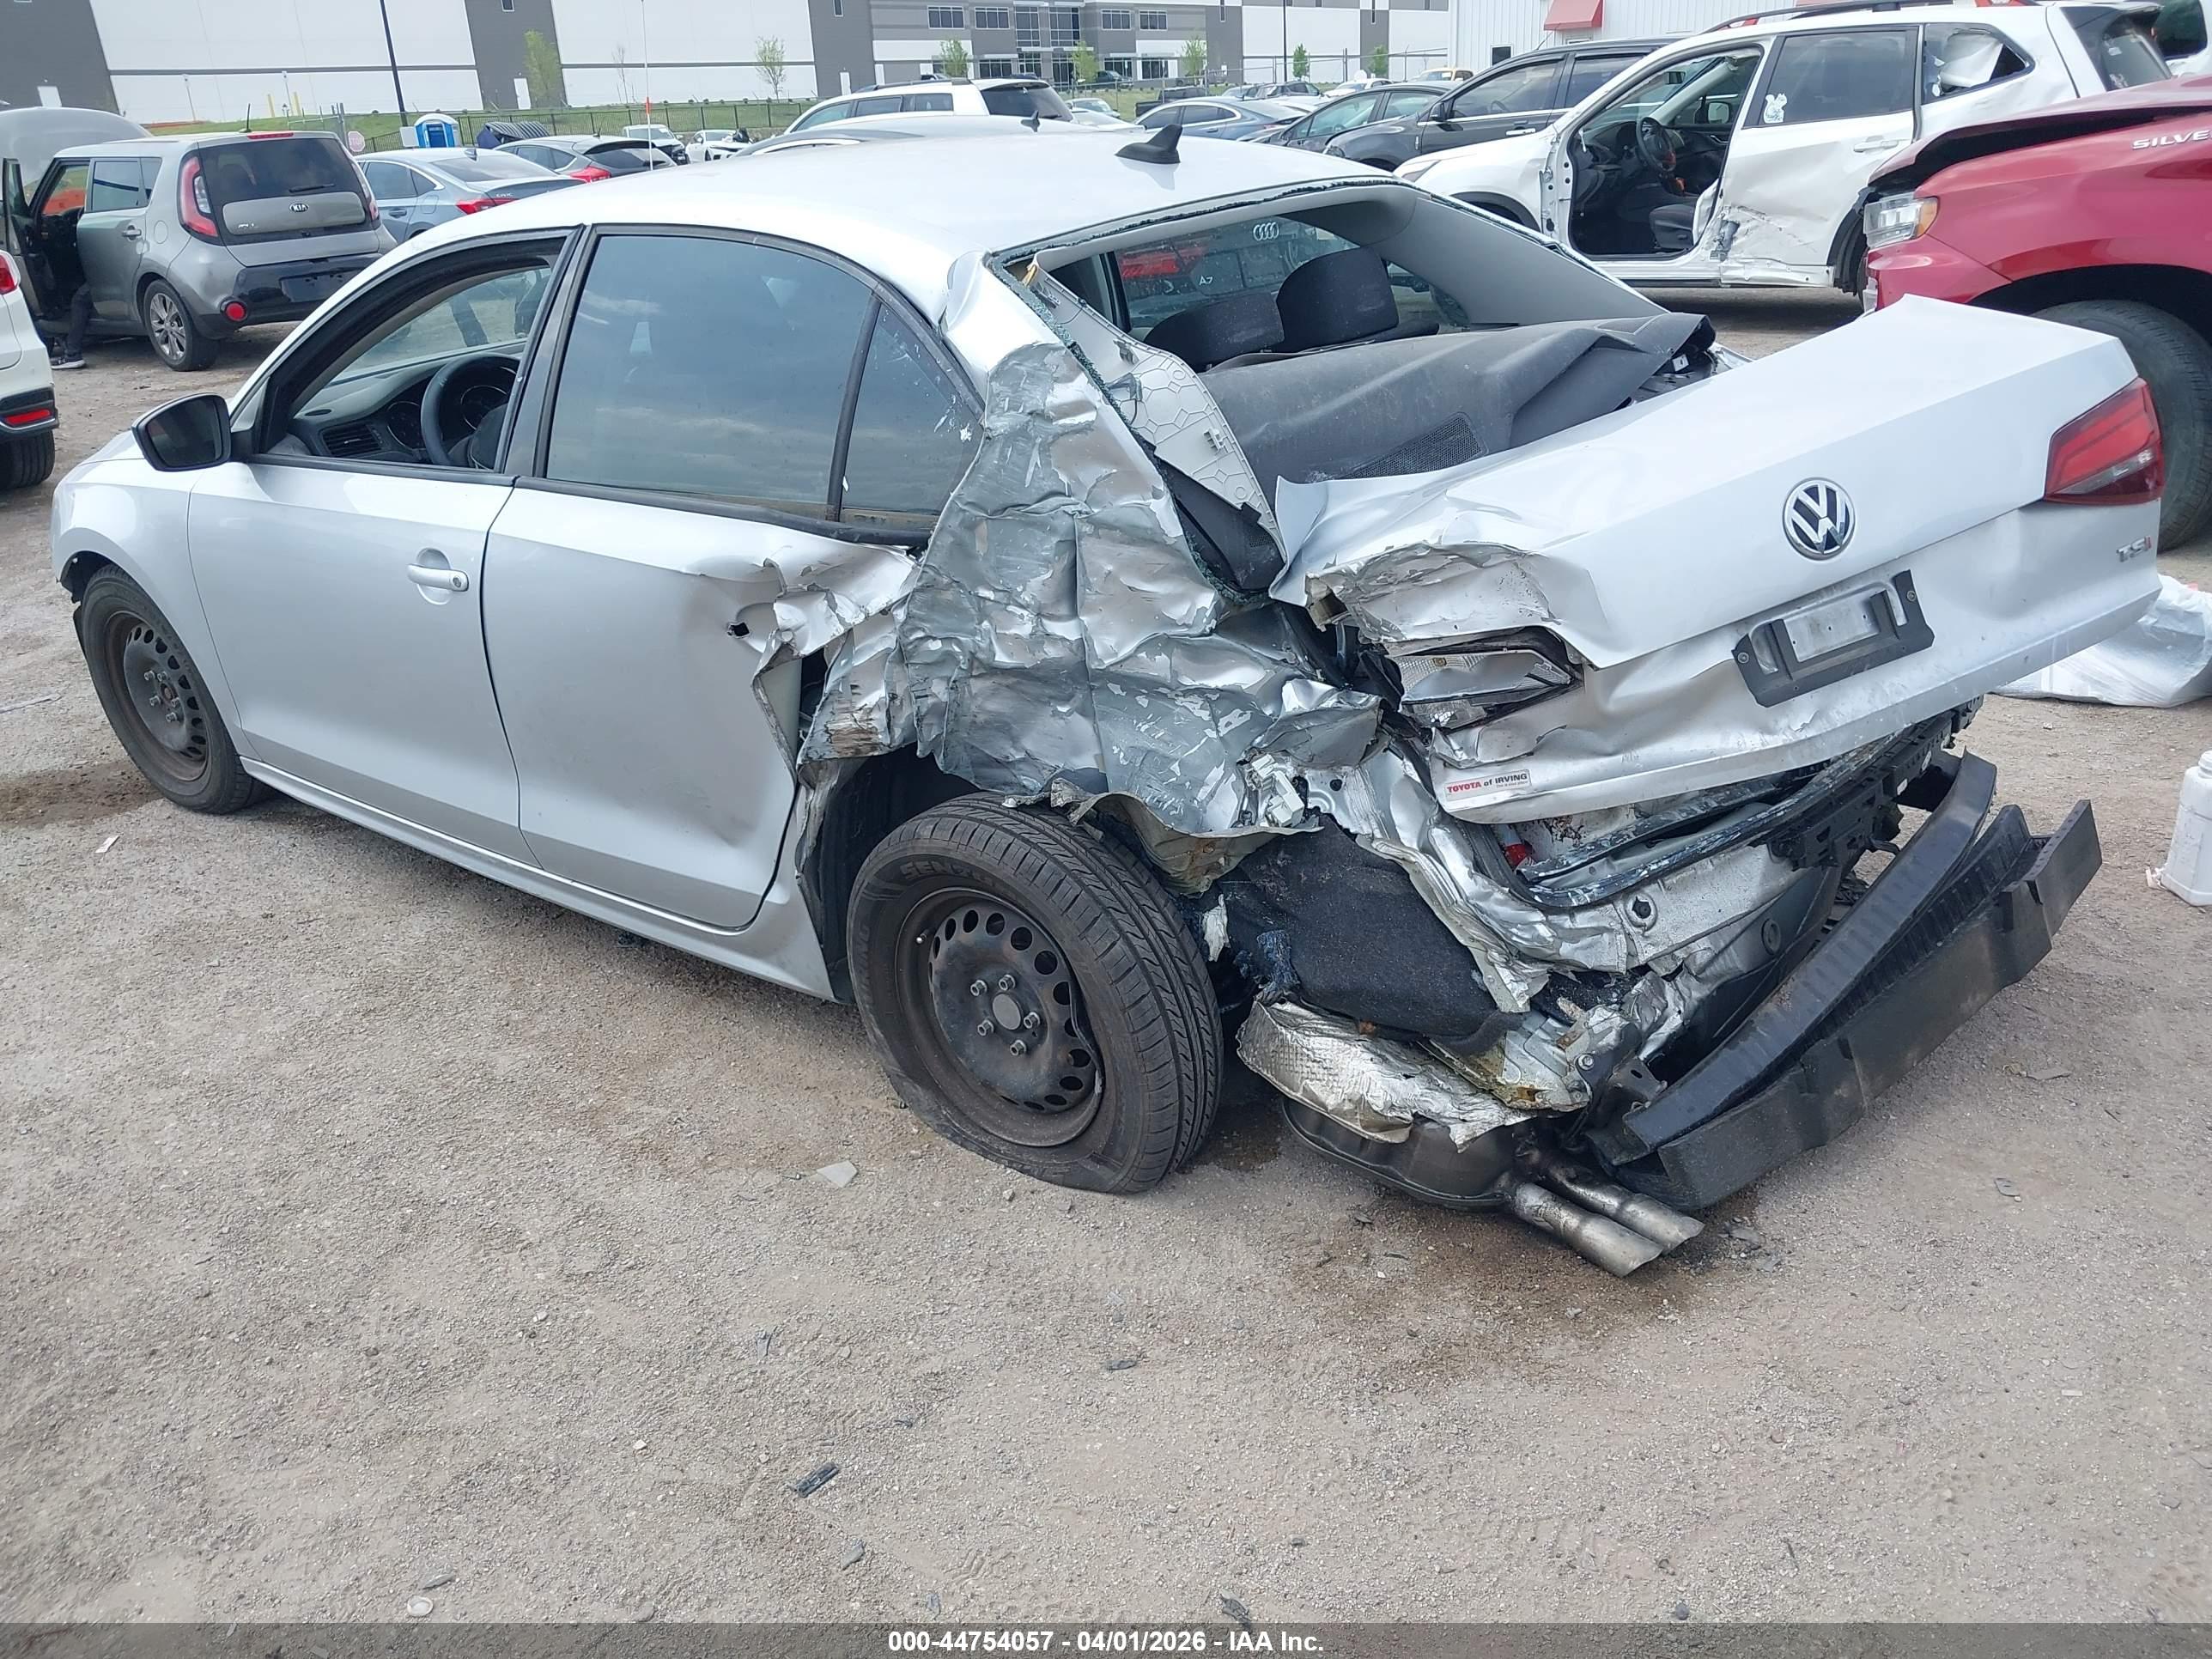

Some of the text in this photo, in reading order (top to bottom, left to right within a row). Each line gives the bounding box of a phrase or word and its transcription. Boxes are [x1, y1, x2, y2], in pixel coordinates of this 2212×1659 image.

[1199, 275, 1213, 286] A7
[1447, 781, 1482, 793] TOYOTA
[1495, 773, 1528, 784] IRVING
